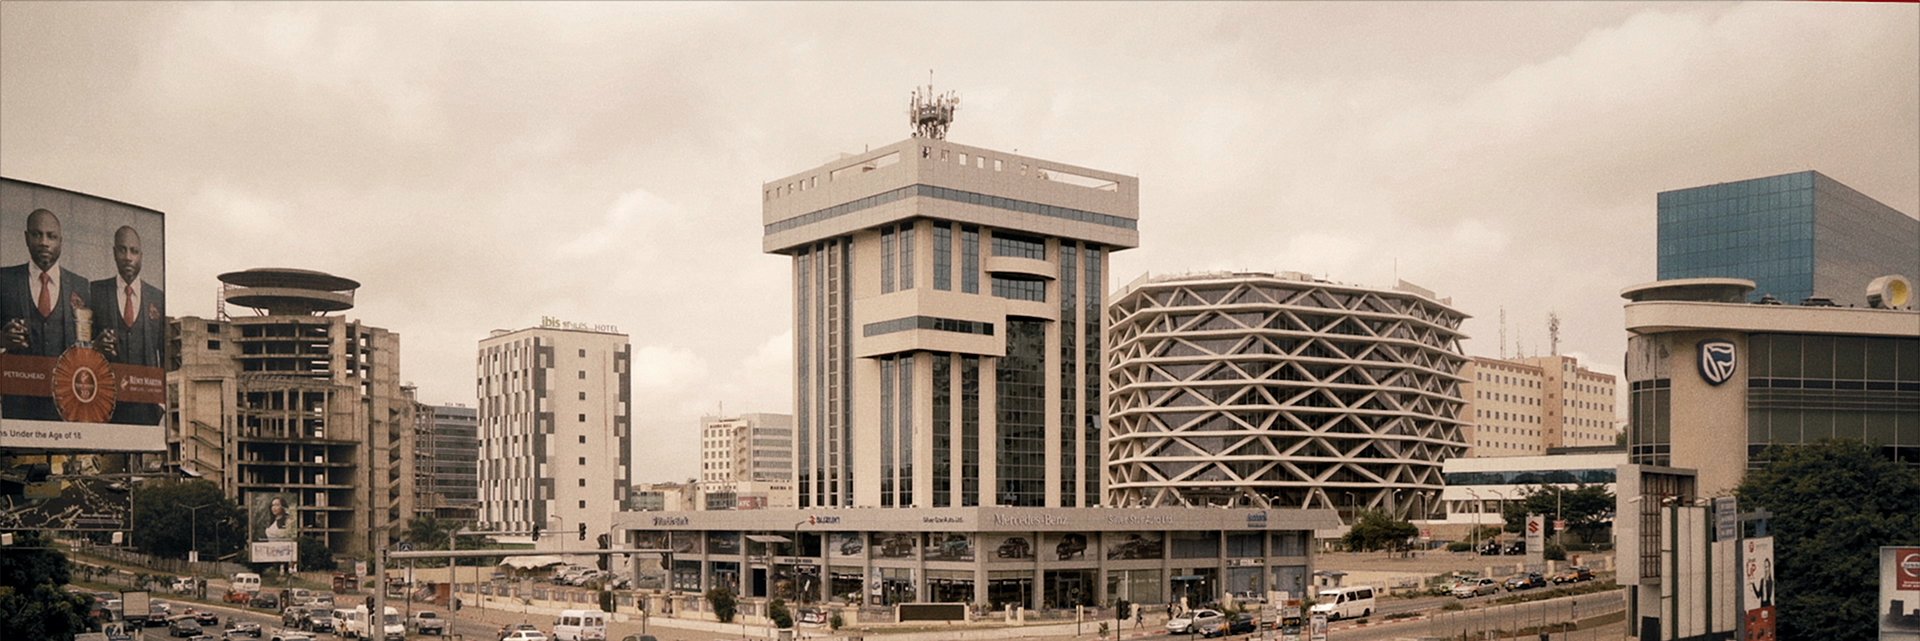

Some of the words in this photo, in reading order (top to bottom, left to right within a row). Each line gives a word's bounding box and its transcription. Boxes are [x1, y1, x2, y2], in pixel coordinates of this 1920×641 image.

[542, 316, 561, 327] ibis
[594, 324, 619, 332] HOTEL
[9, 429, 33, 438] Under
[48, 432, 63, 441] Age
[994, 512, 1068, 526] Mercedes-Benz
